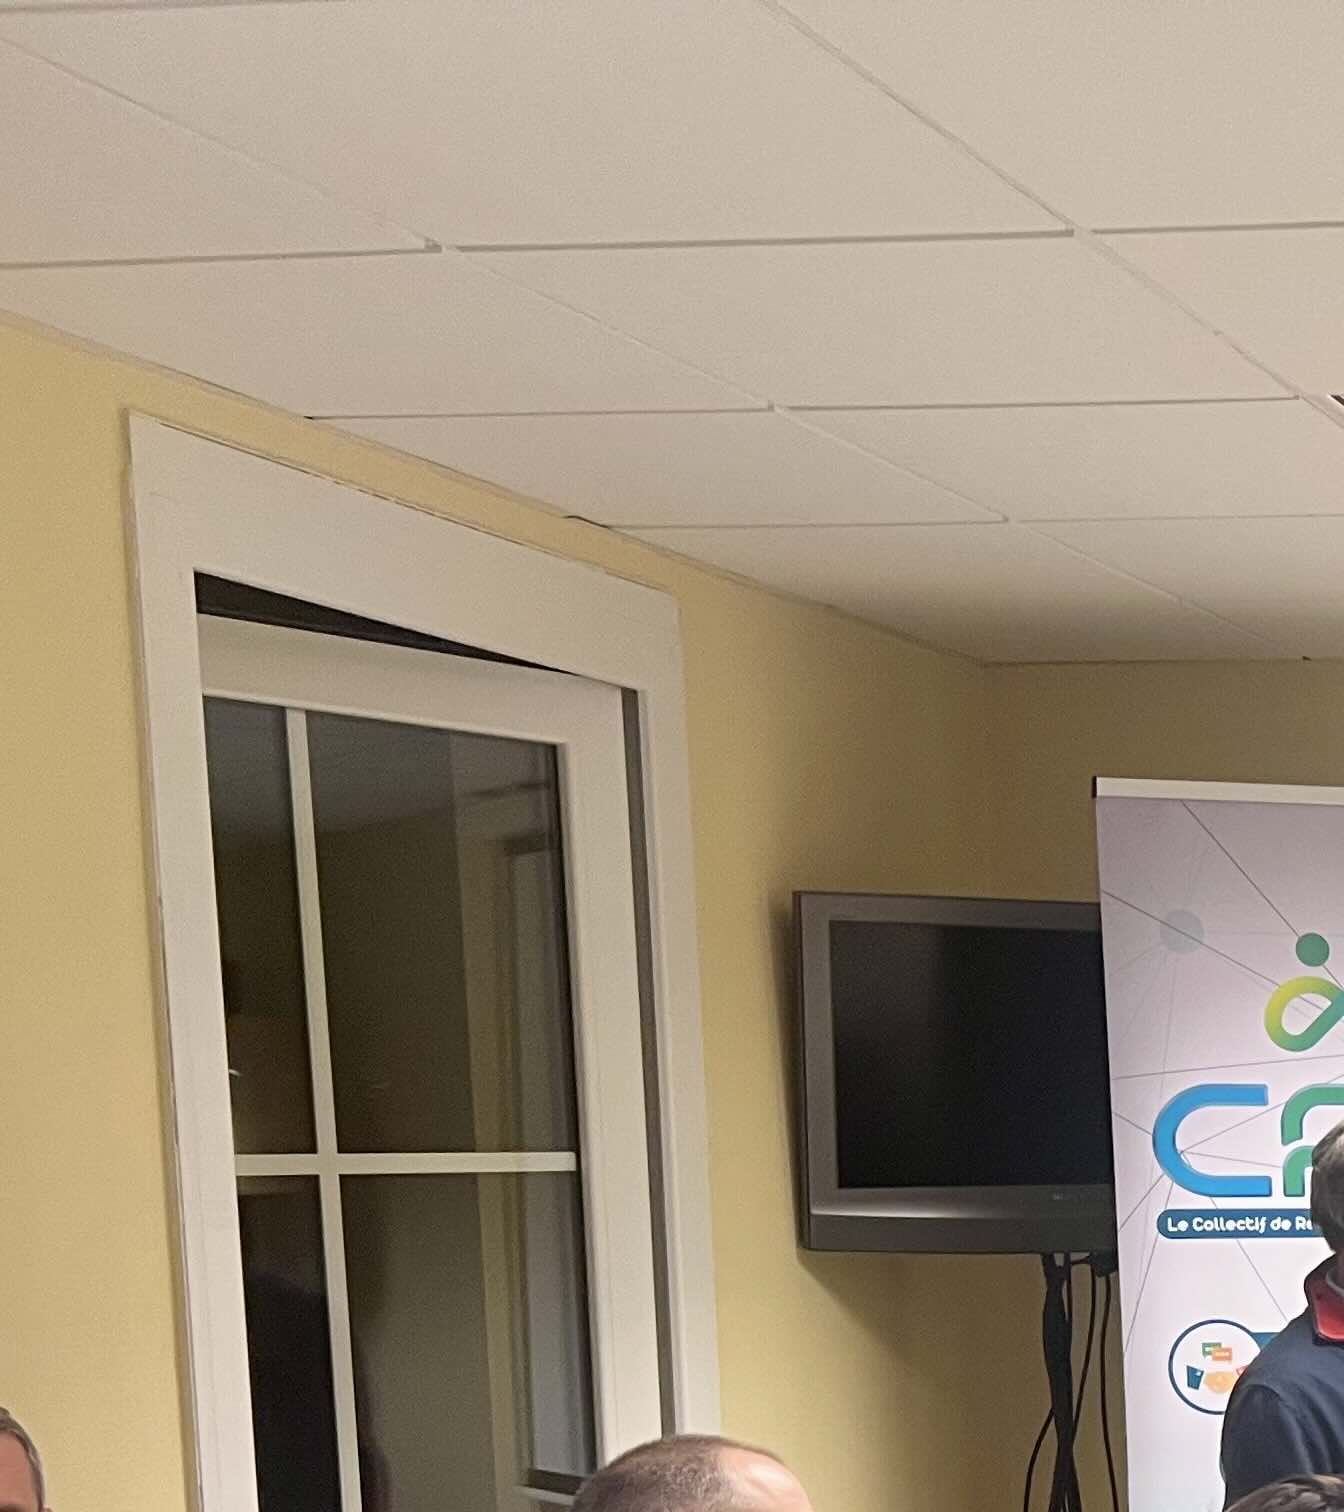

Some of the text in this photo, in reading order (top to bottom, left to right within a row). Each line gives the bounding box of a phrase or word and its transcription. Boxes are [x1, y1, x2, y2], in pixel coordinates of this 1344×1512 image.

[1167, 1216, 1189, 1232] Le
[1192, 1216, 1267, 1234] Collectif
[1270, 1216, 1292, 1231] de
